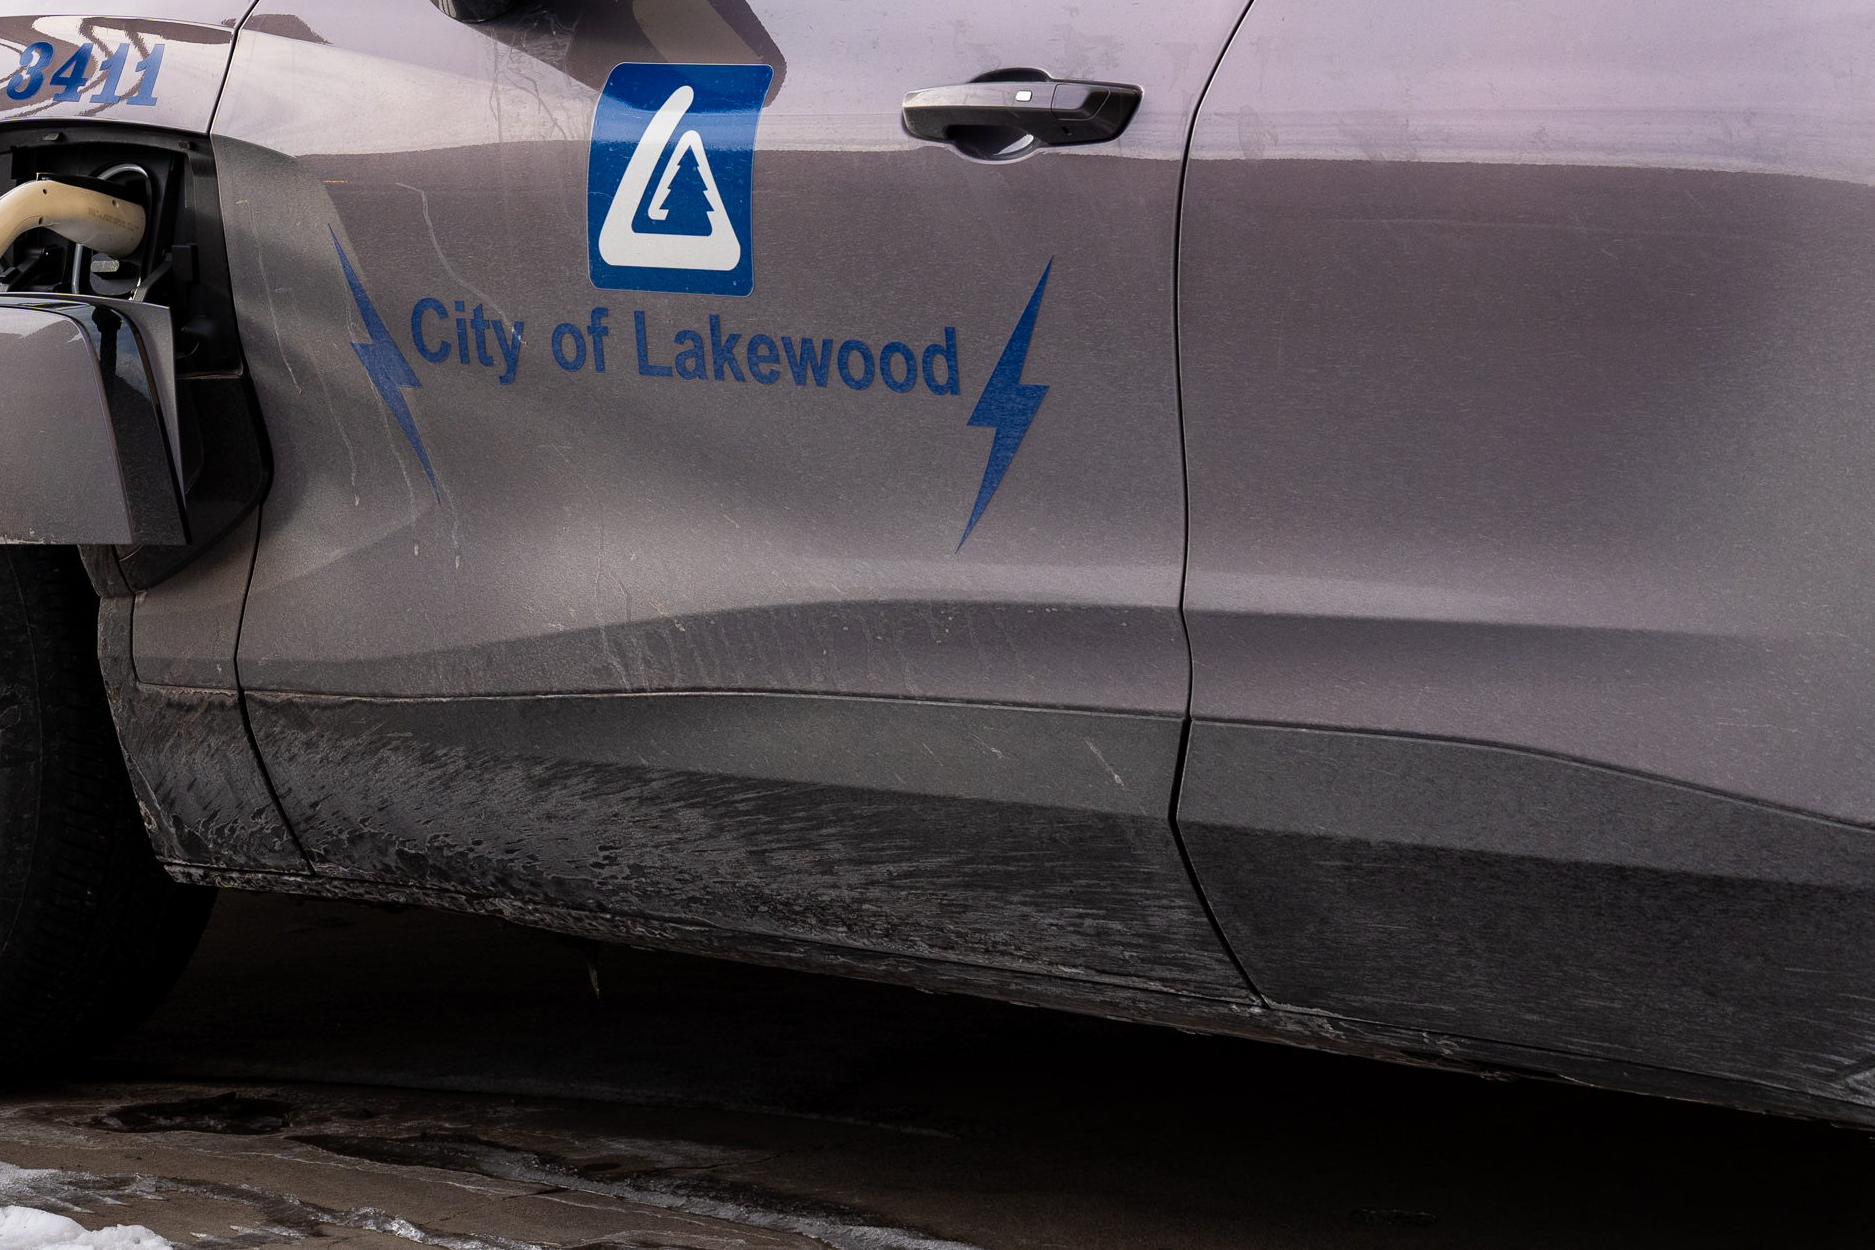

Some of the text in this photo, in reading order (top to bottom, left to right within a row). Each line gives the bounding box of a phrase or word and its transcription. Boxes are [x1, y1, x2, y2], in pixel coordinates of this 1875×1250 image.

[6, 41, 166, 106] 3411
[410, 297, 961, 396] City of Lakewood
